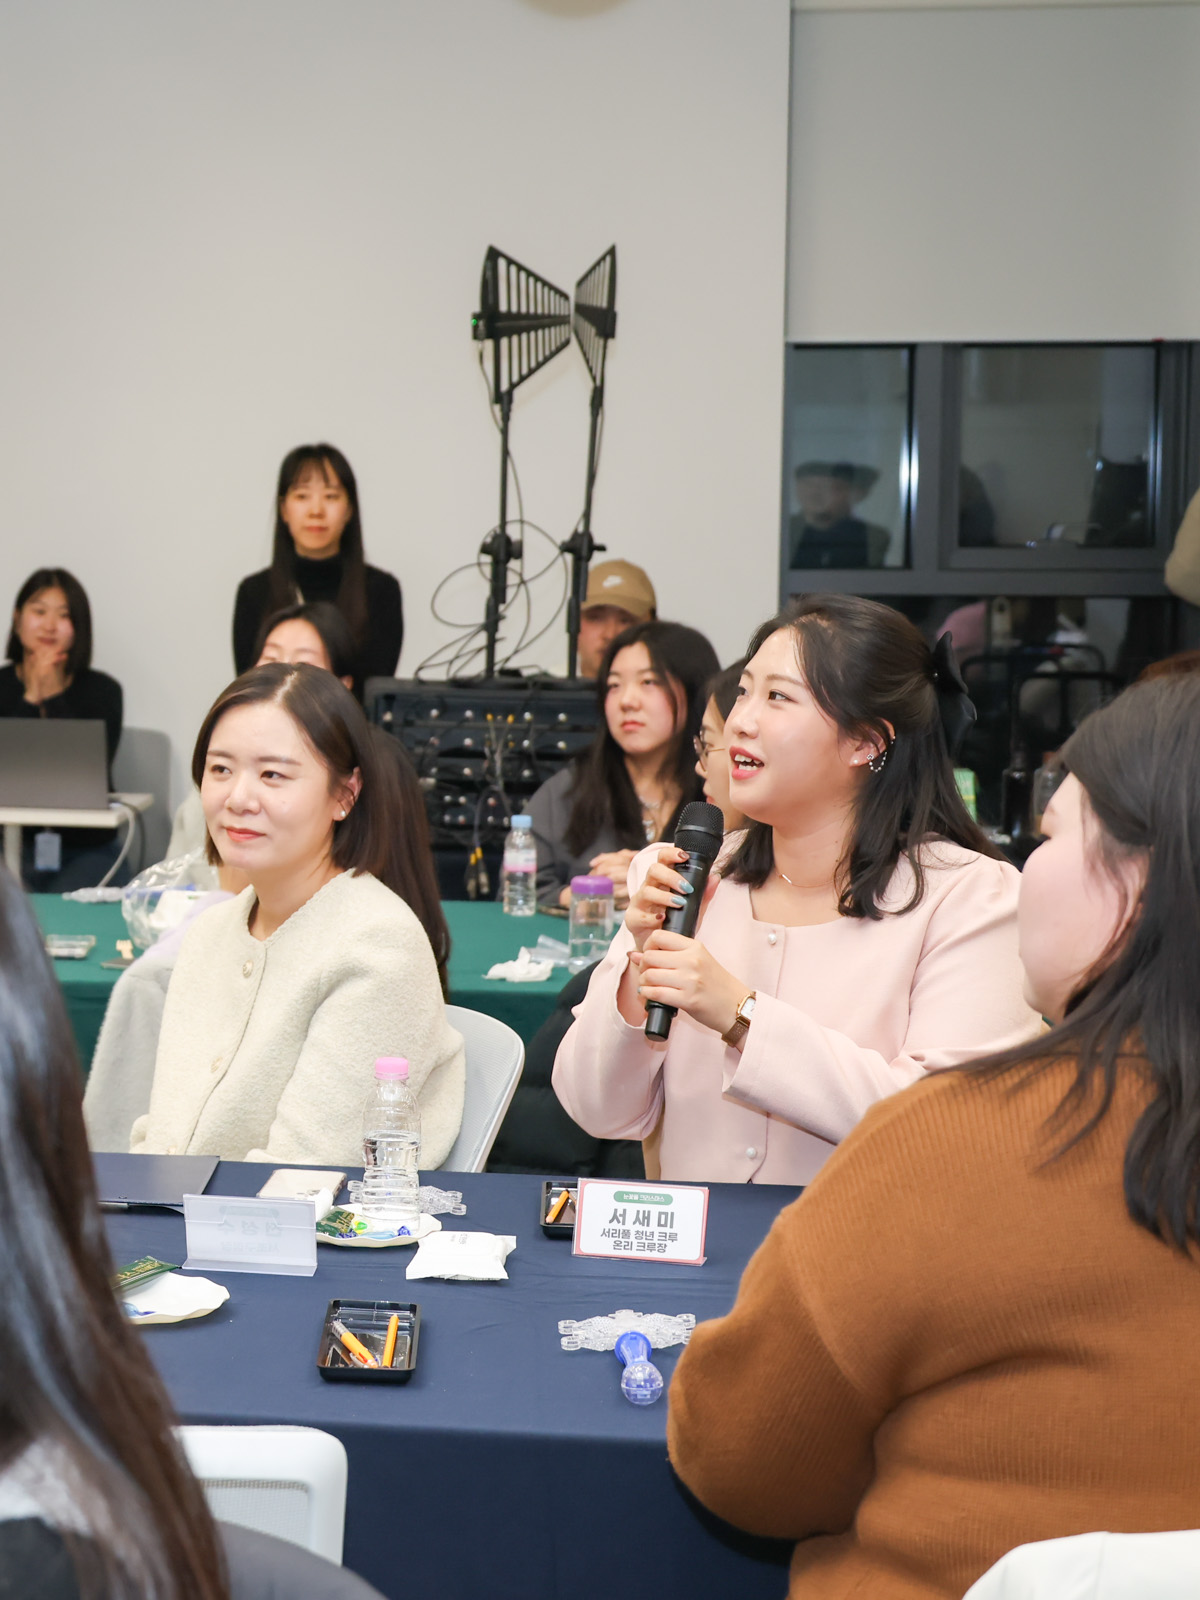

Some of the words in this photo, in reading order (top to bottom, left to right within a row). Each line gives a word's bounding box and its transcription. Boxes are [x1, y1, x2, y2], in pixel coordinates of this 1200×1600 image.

[600, 1227, 631, 1240] 서리풀
[634, 1229, 655, 1241] 청년
[657, 1231, 678, 1243] 크루
[613, 1240, 633, 1251] 온리
[635, 1241, 667, 1253] 크루장
